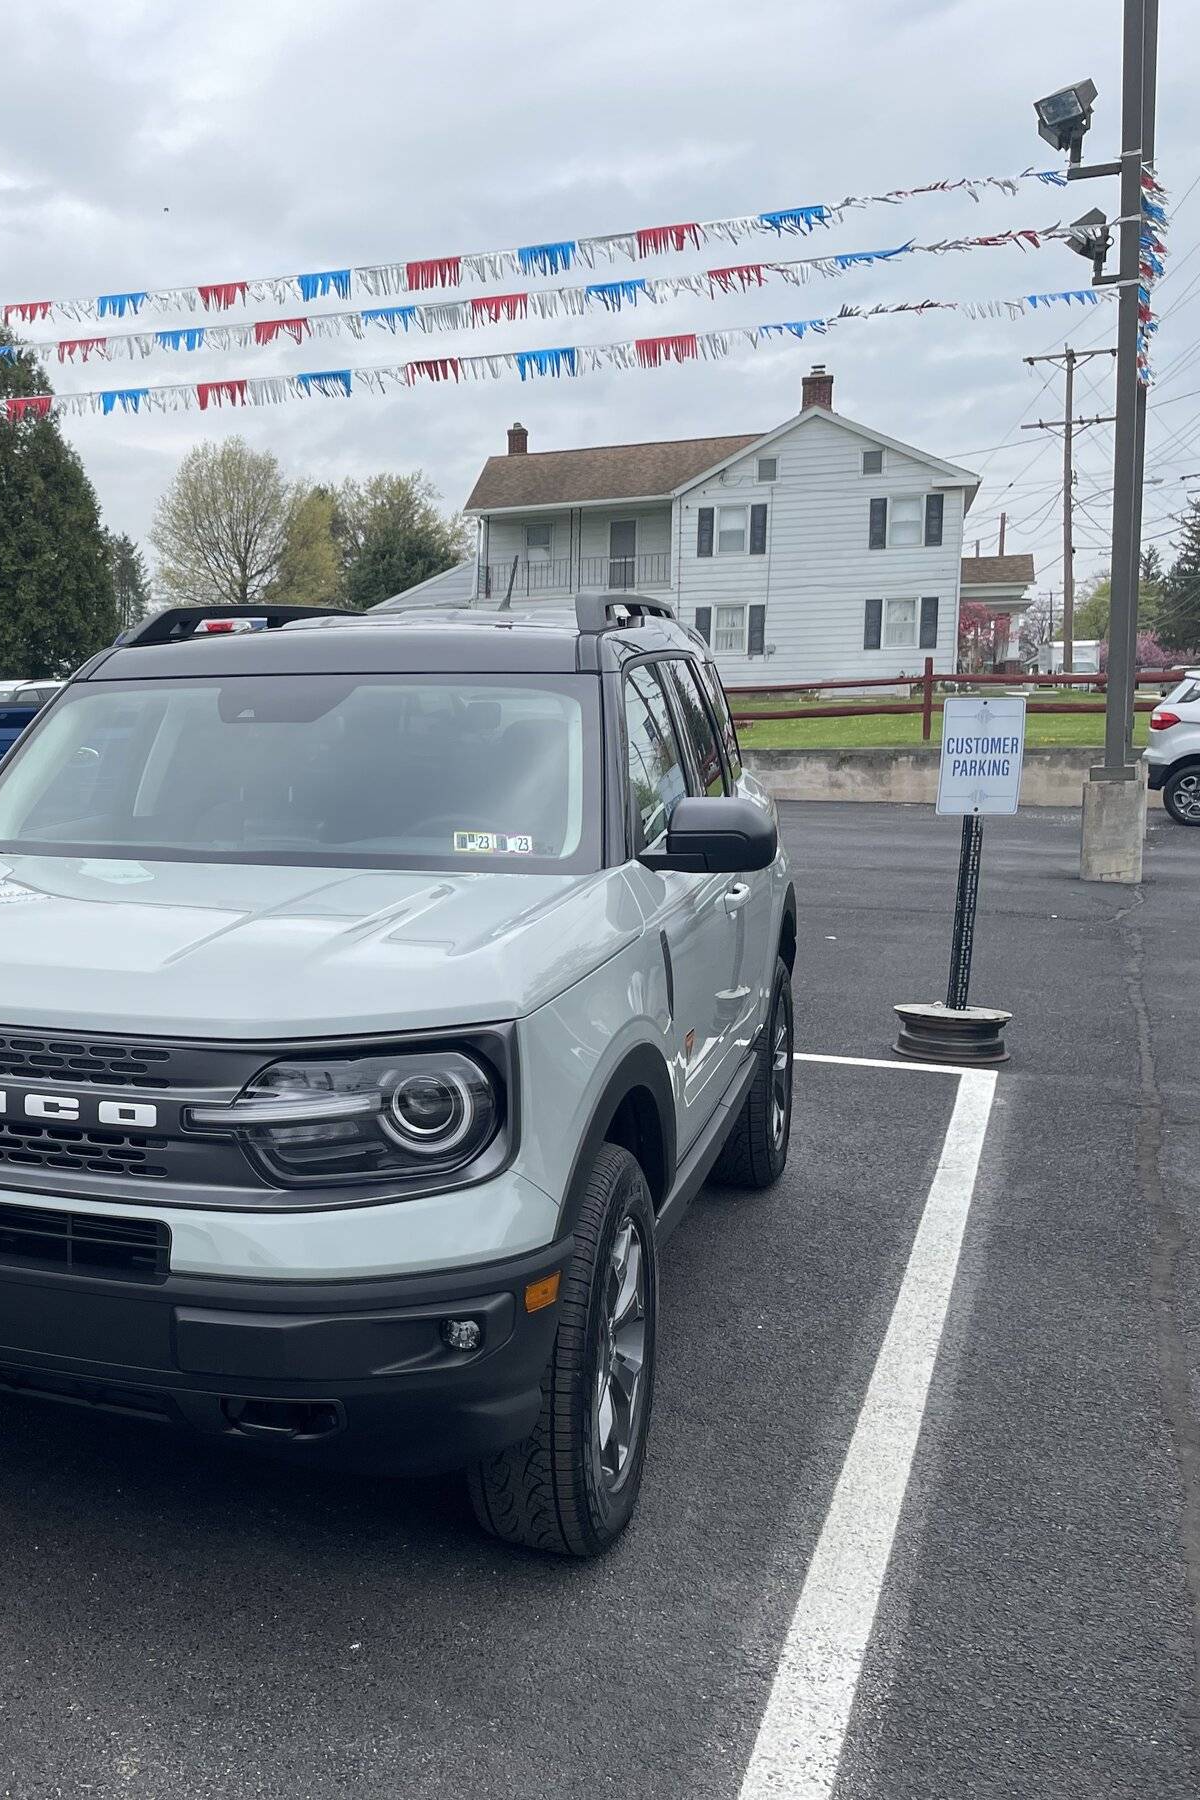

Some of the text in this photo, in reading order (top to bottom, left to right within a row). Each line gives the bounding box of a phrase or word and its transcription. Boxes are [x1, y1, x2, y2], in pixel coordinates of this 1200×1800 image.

[946, 737, 1019, 755] CUSTOMER
[952, 759, 1010, 777] PARKING
[478, 836, 489, 849] 23
[518, 838, 529, 851] 23
